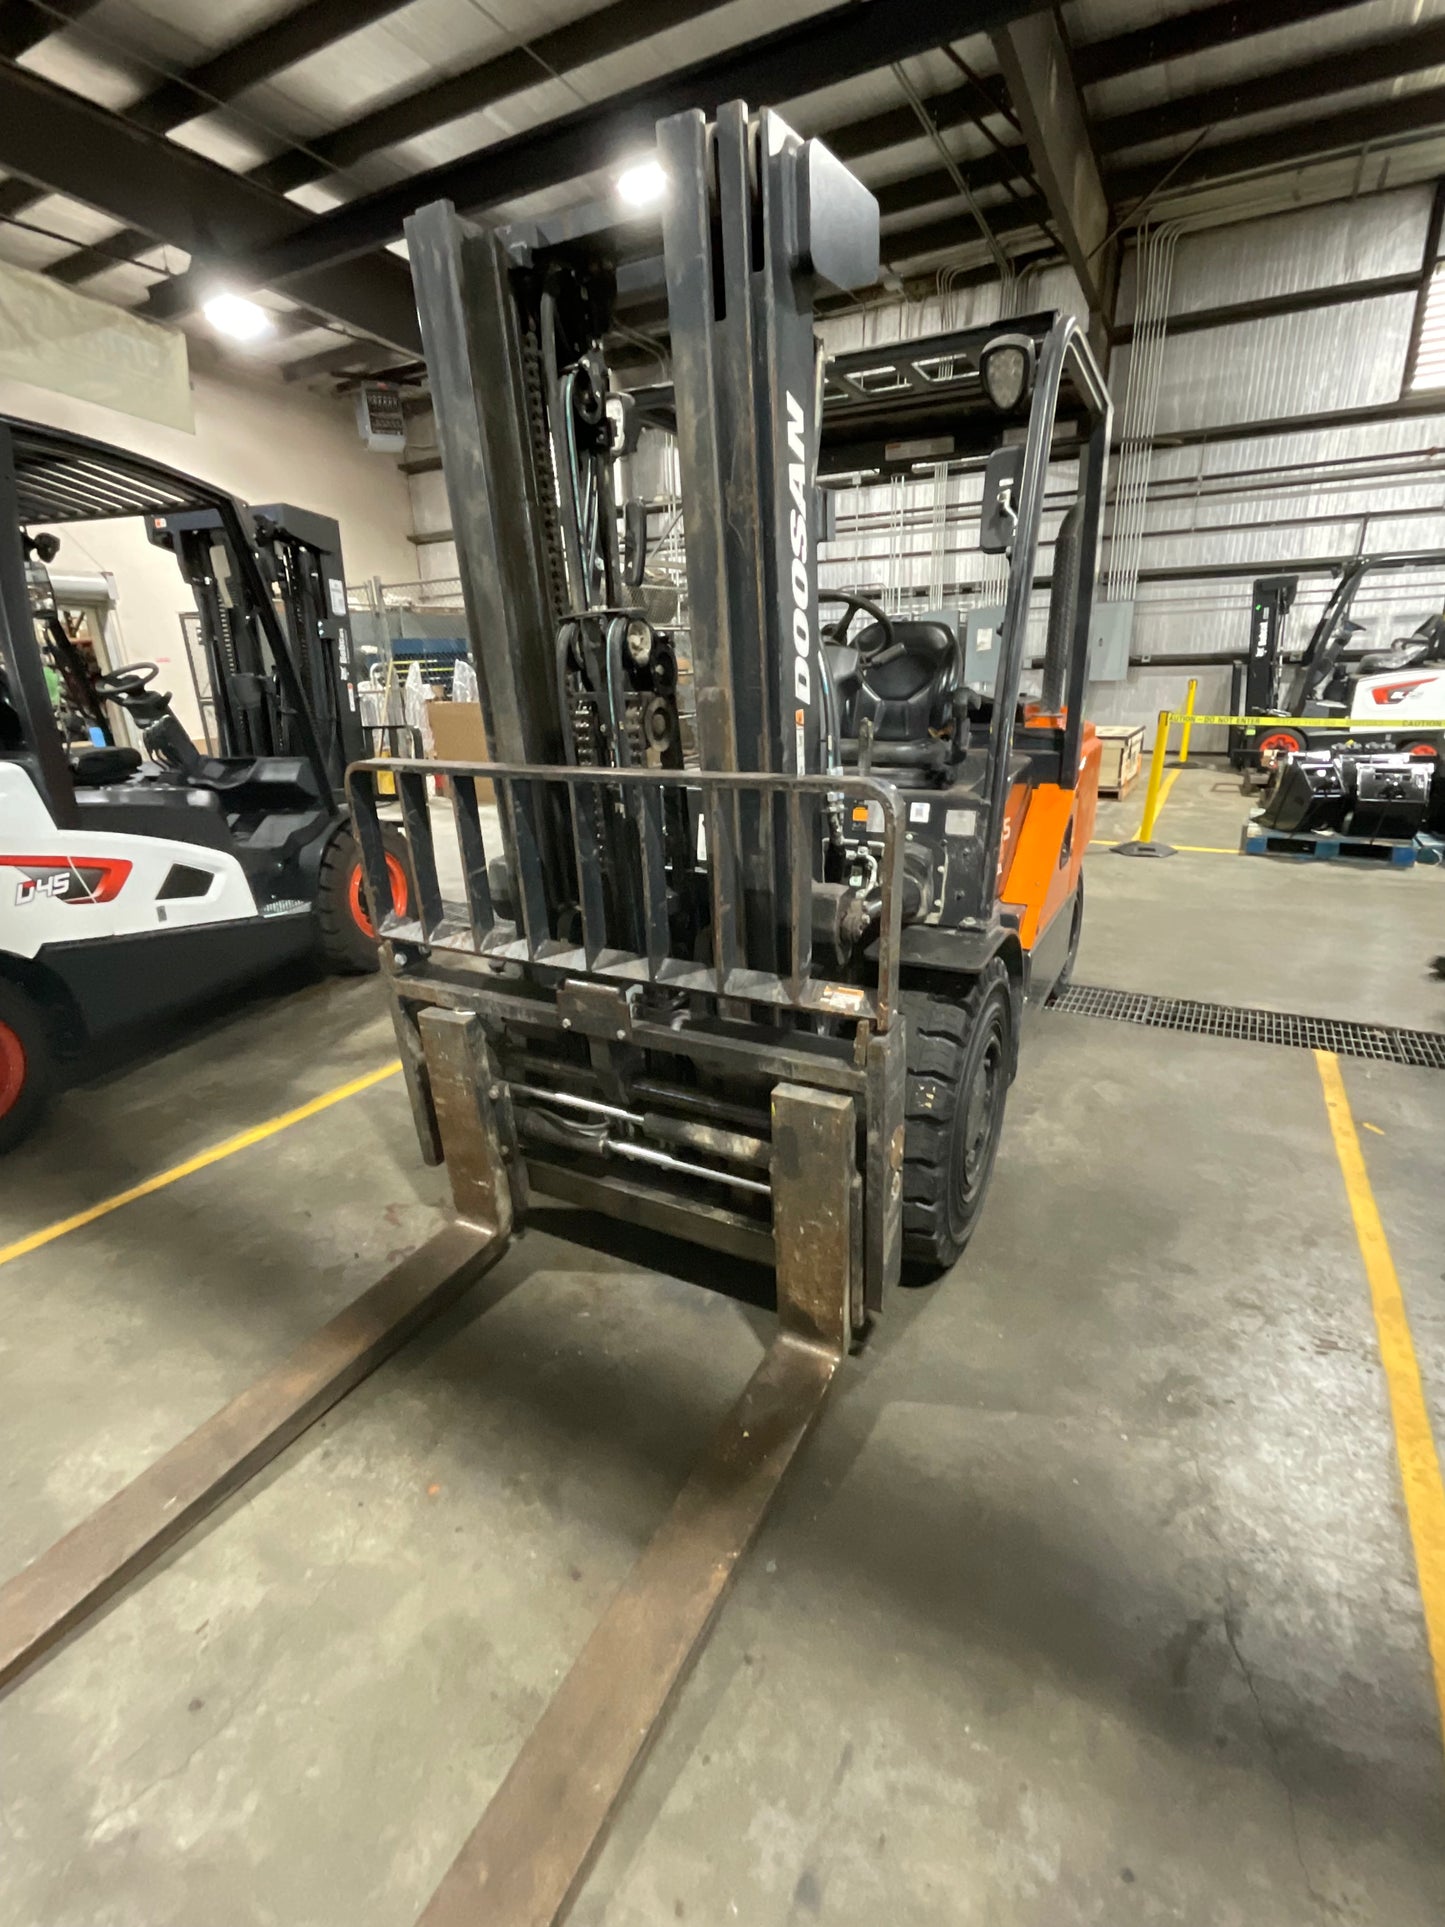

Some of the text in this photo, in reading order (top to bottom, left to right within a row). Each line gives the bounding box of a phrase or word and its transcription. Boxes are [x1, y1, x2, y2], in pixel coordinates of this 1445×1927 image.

[786, 390, 811, 705] DOOSAN
[1168, 714, 1196, 723] AUTION
[1204, 715, 1216, 723] DO
[1218, 716, 1233, 724] NOT
[1236, 716, 1260, 724] ENTER
[15, 872, 70, 906] D45
